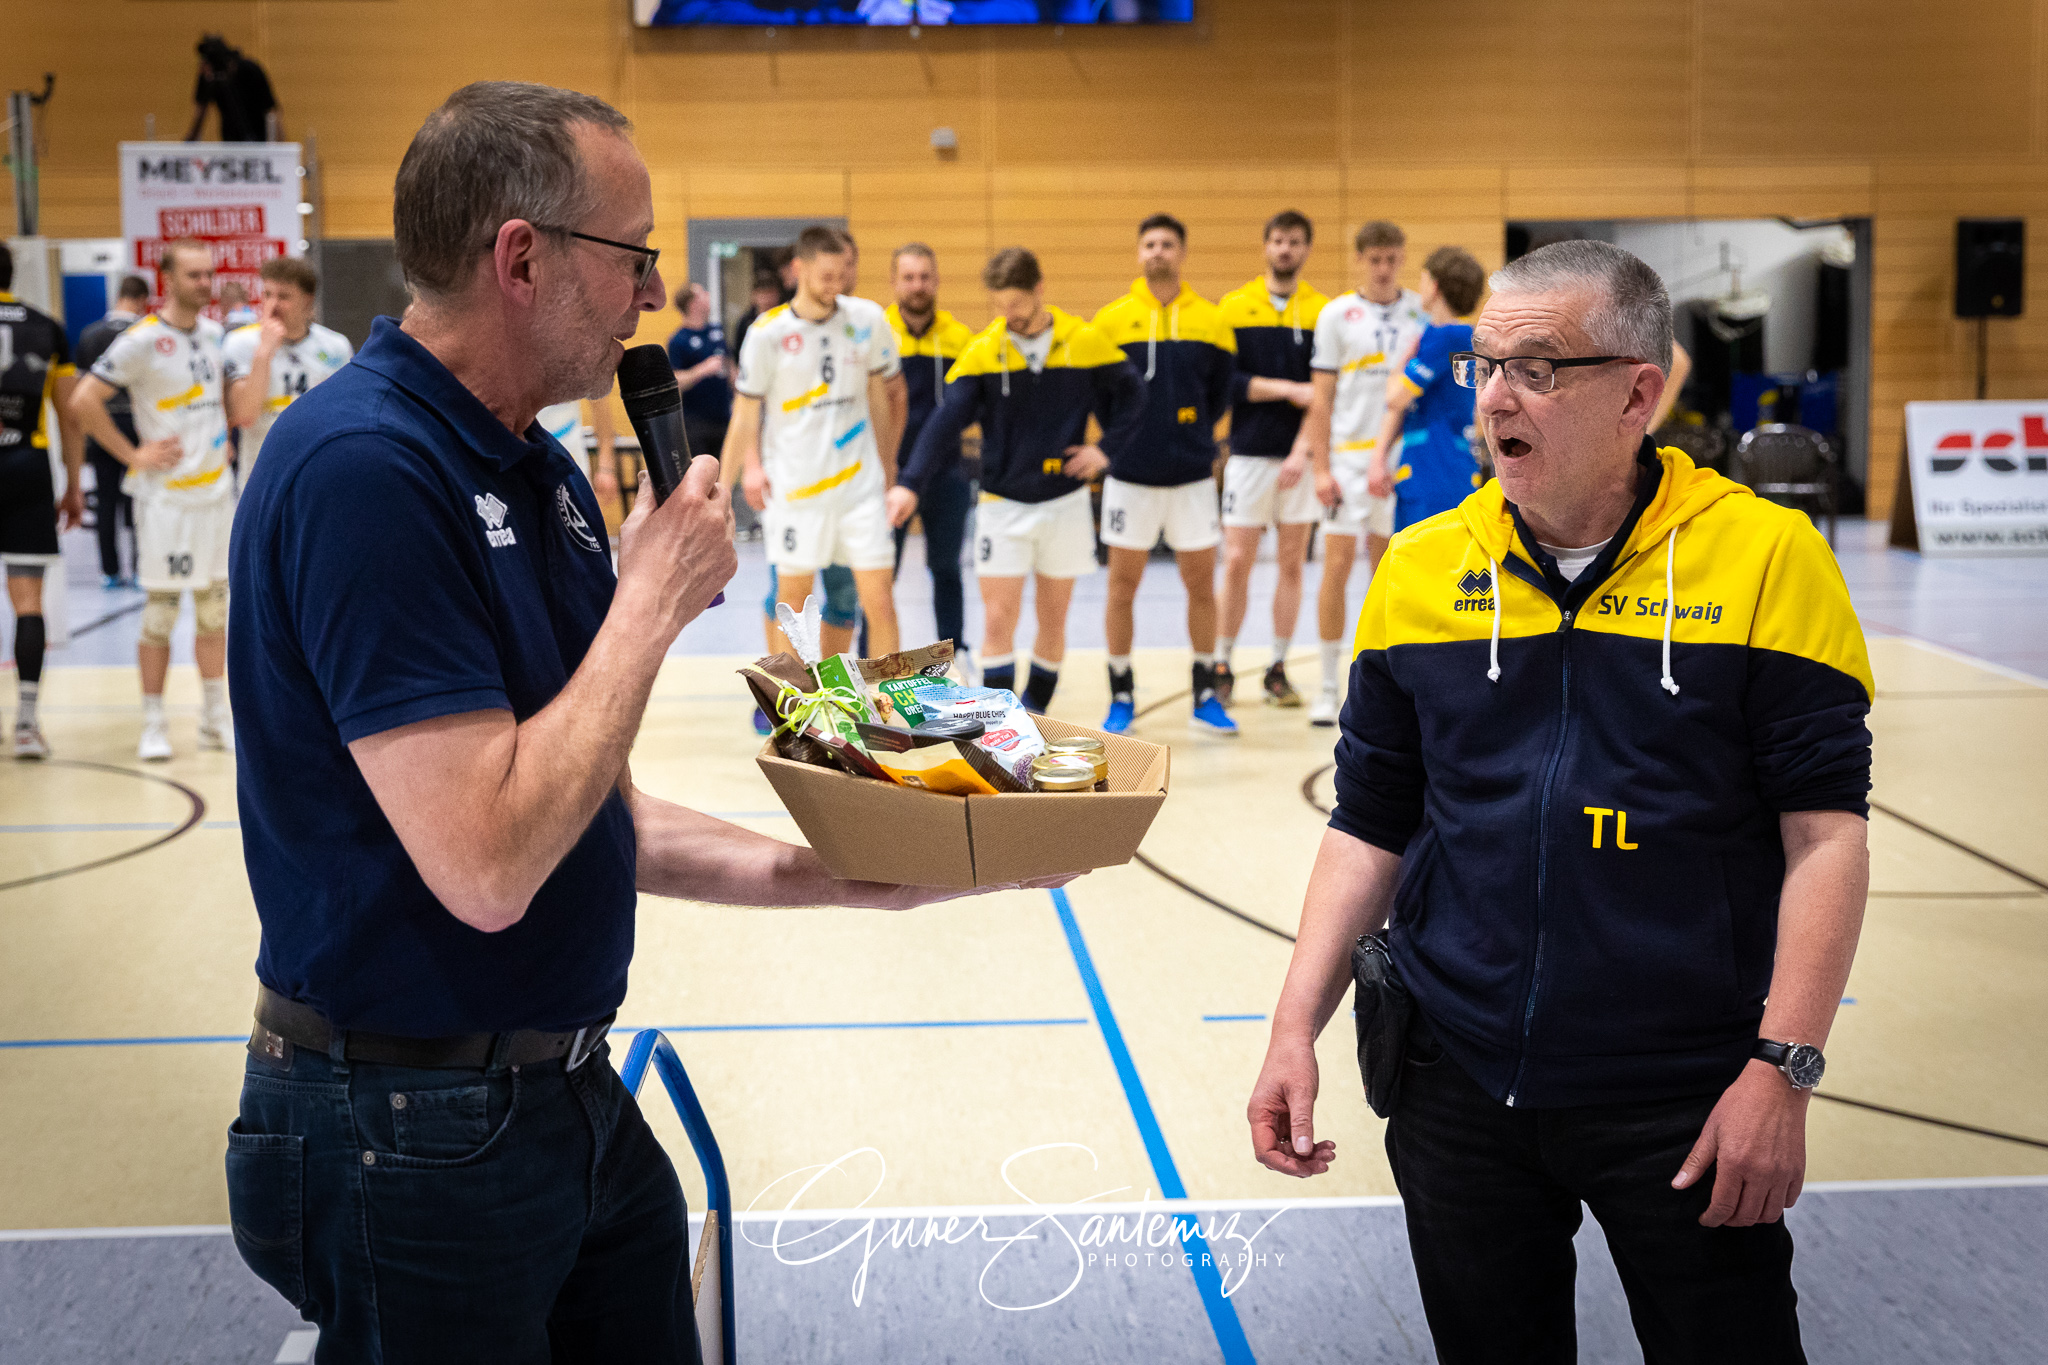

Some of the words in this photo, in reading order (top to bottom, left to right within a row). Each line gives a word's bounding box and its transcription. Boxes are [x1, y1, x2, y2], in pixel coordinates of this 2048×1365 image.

[139, 157, 283, 184] MEYSEL
[821, 354, 835, 384] 6
[783, 527, 797, 551] 6
[980, 537, 993, 562] 9
[167, 554, 194, 577] 10
[1454, 597, 1496, 612] errea
[1598, 595, 1628, 615] SV
[886, 677, 934, 692] KARTOFFEL
[893, 688, 918, 707] CH
[953, 711, 975, 720] HAPPY
[975, 710, 991, 720] BLUE
[991, 710, 1007, 719] CHIPS
[1583, 806, 1639, 850] TL
